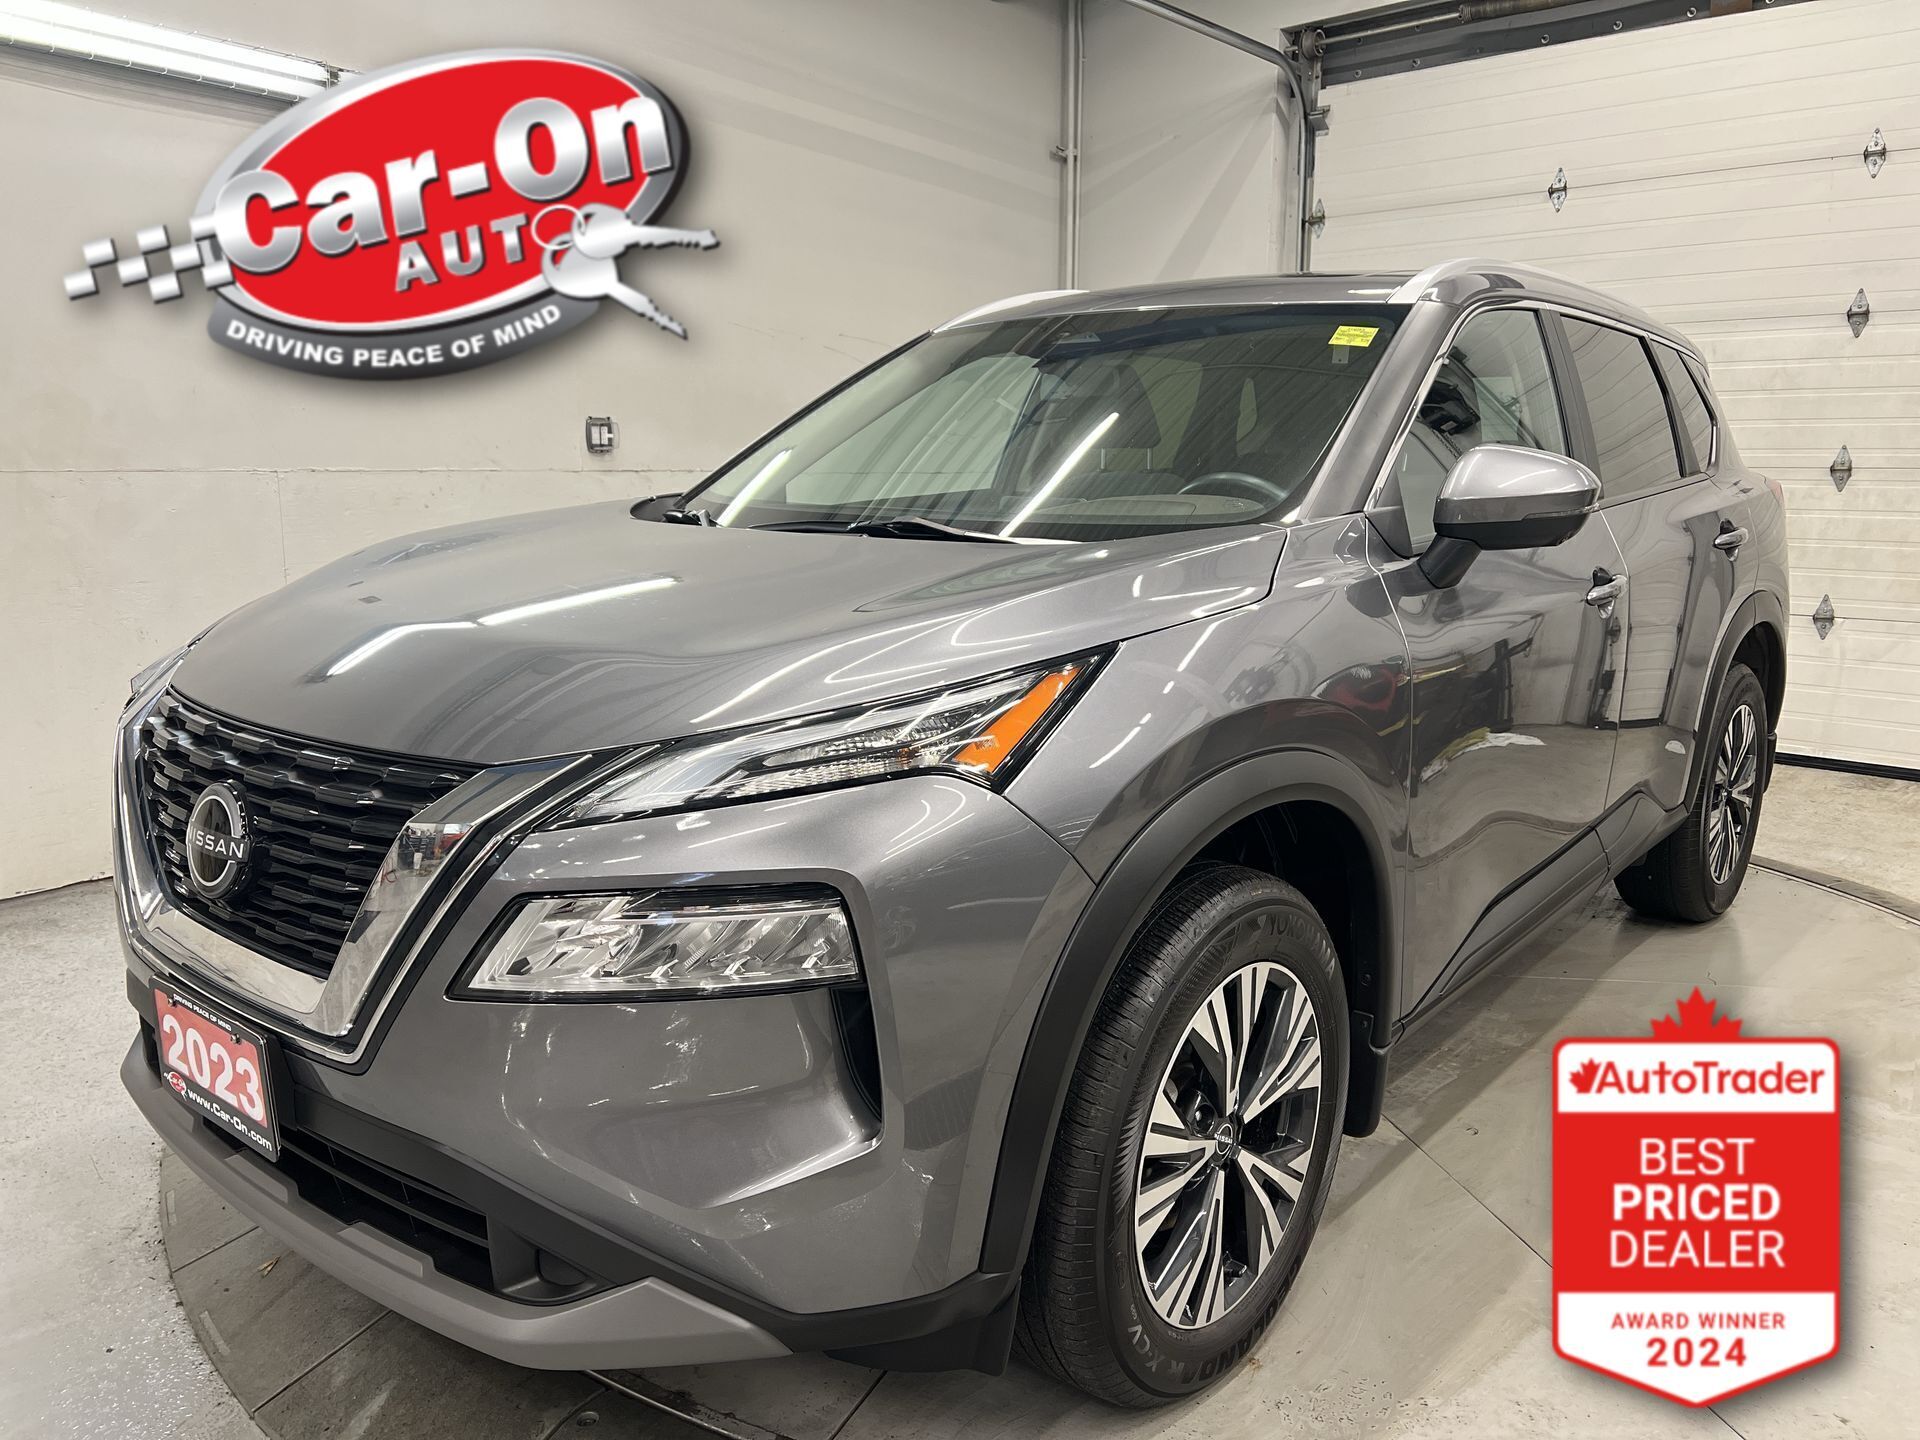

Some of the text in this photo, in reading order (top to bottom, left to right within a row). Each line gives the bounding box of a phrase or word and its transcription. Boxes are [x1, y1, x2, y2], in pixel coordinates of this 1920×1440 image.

[188, 825, 244, 858] NISSAN
[162, 1014, 264, 1122] 2023
[187, 1089, 273, 1152] www.Car-On.com
